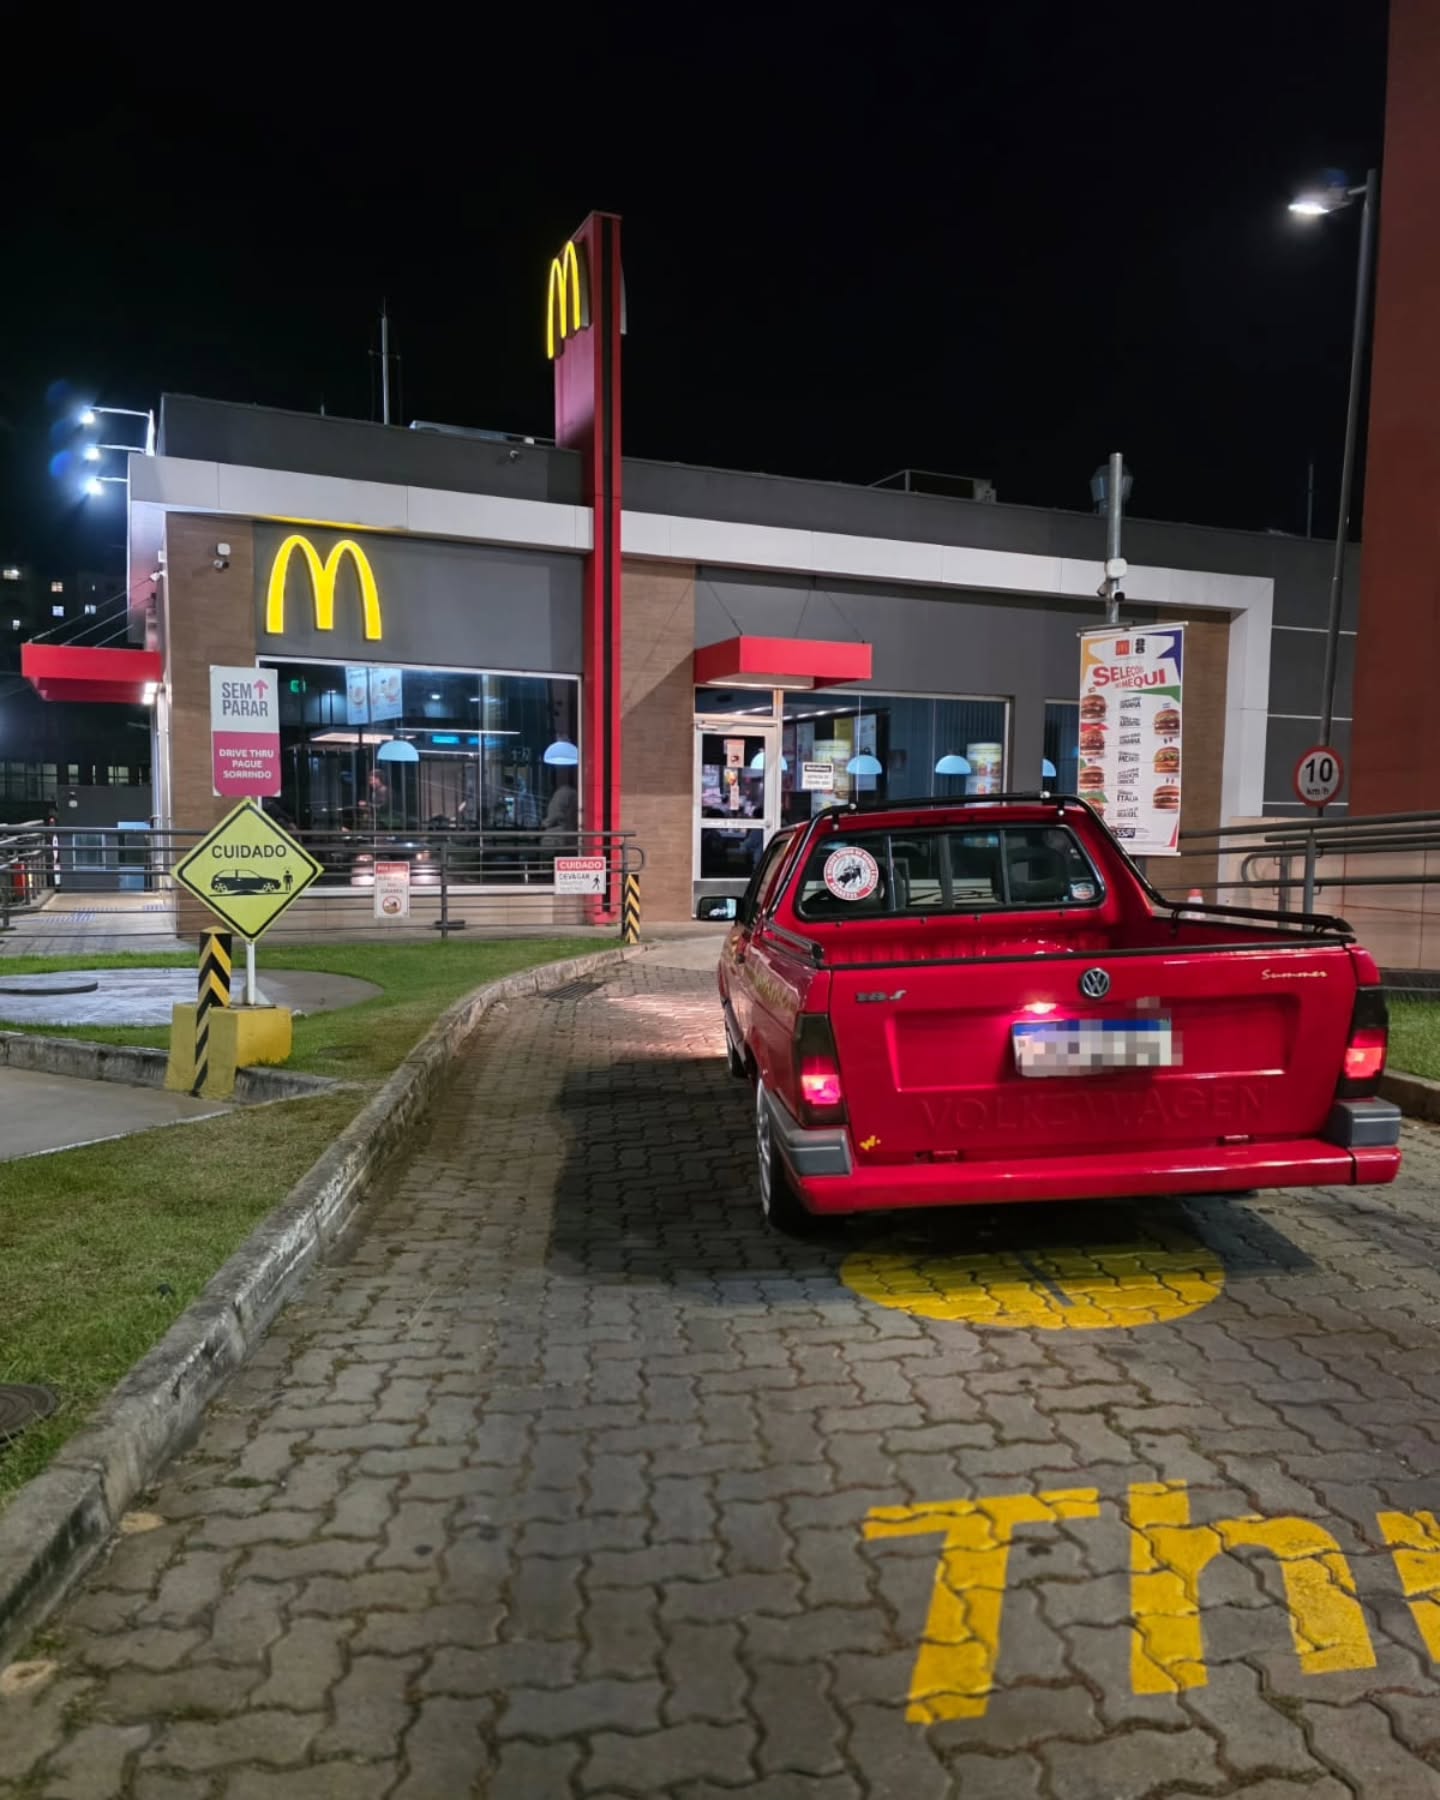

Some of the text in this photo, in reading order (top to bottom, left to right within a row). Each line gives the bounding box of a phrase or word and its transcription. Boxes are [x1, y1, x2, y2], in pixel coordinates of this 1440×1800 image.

[221, 682, 252, 700] SEM
[222, 700, 269, 717] PARAR
[219, 749, 274, 758] DRIVE THRU
[232, 760, 263, 768] PAGUE
[1305, 757, 1333, 783] 10
[223, 770, 272, 779] SORRINDO
[211, 844, 287, 858] CUIDADO
[559, 861, 601, 869] CUIDADO
[1261, 969, 1328, 981] Summer
[921, 1083, 1267, 1135] VOLKSWAGEN
